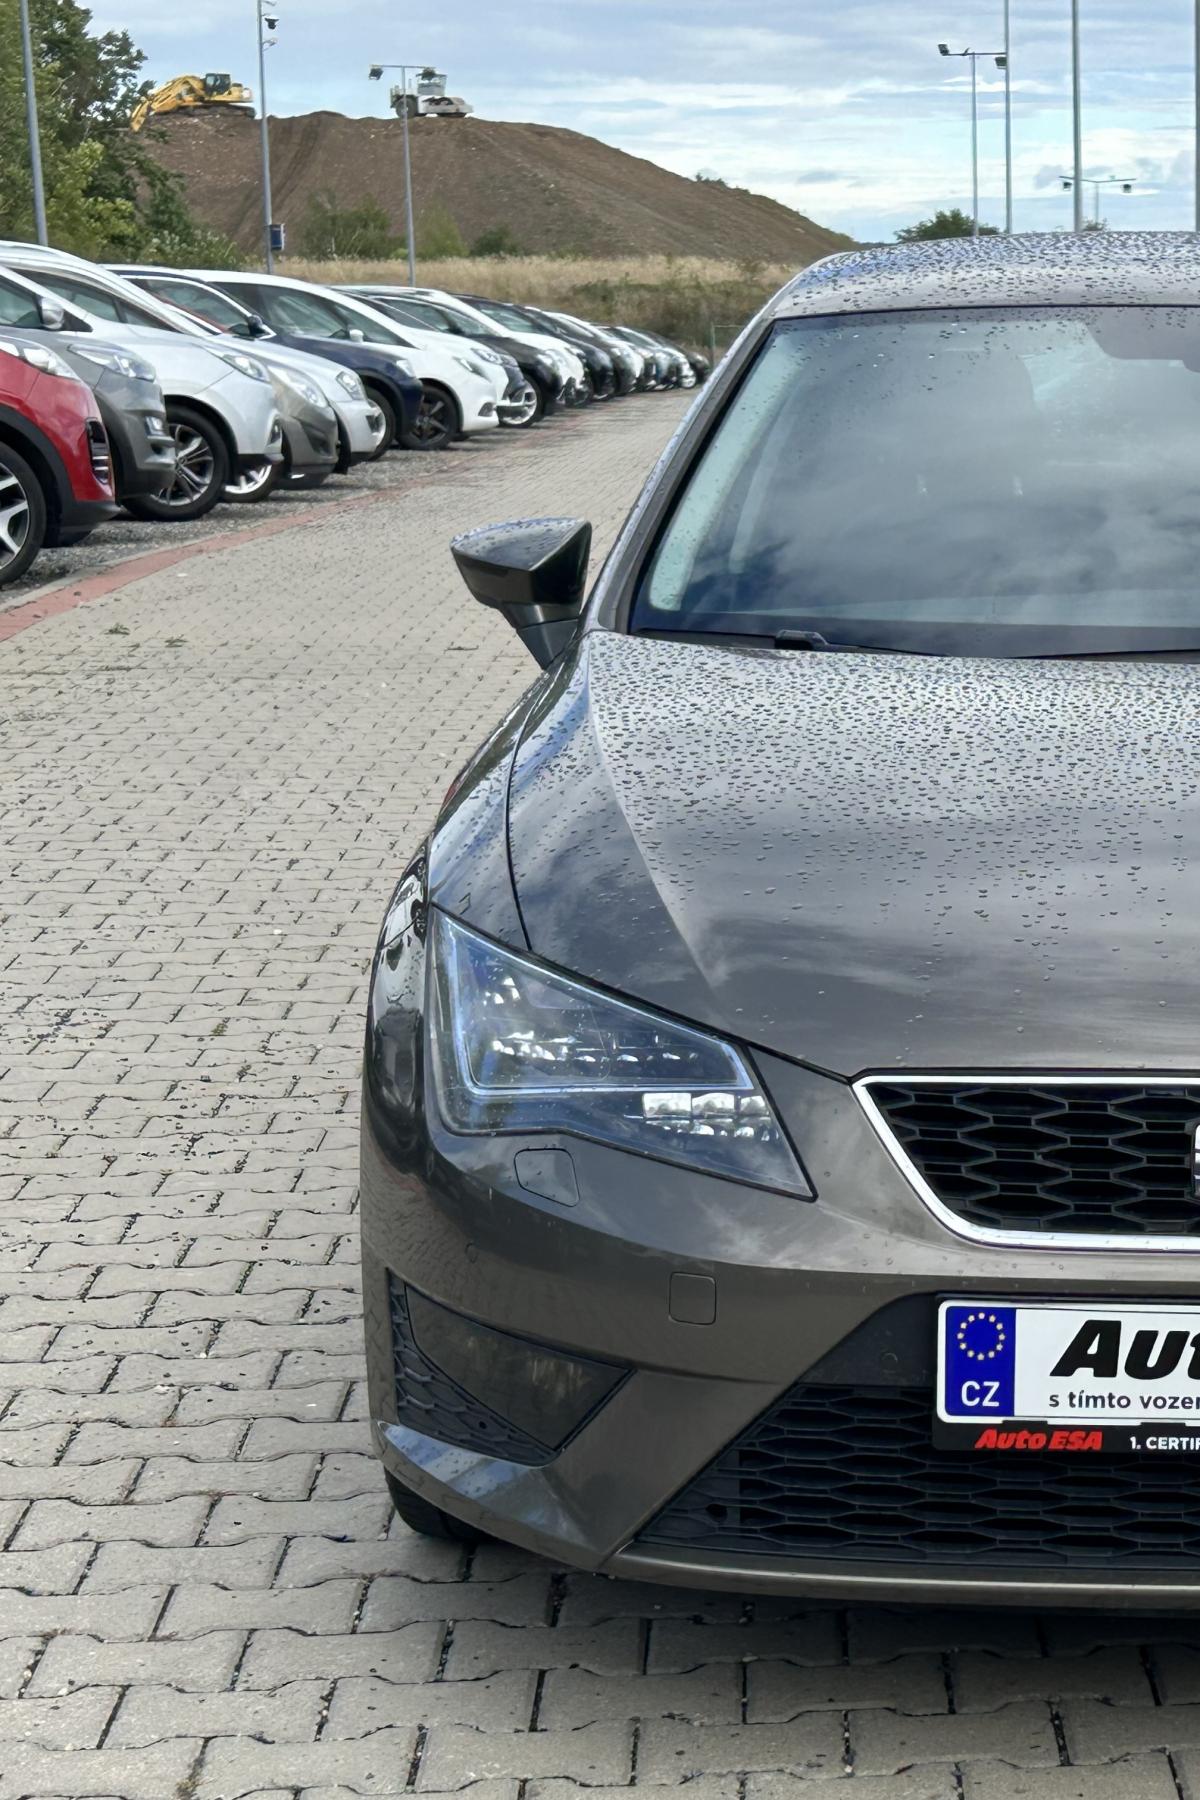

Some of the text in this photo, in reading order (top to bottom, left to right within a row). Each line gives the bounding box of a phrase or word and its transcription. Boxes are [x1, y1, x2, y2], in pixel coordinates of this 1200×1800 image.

[961, 1380, 1000, 1407] CZ
[1048, 1393, 1060, 1408] s
[1068, 1388, 1132, 1409] tímto
[975, 1428, 1104, 1451] Auto ESA
[1129, 1435, 1142, 1450] 1.
